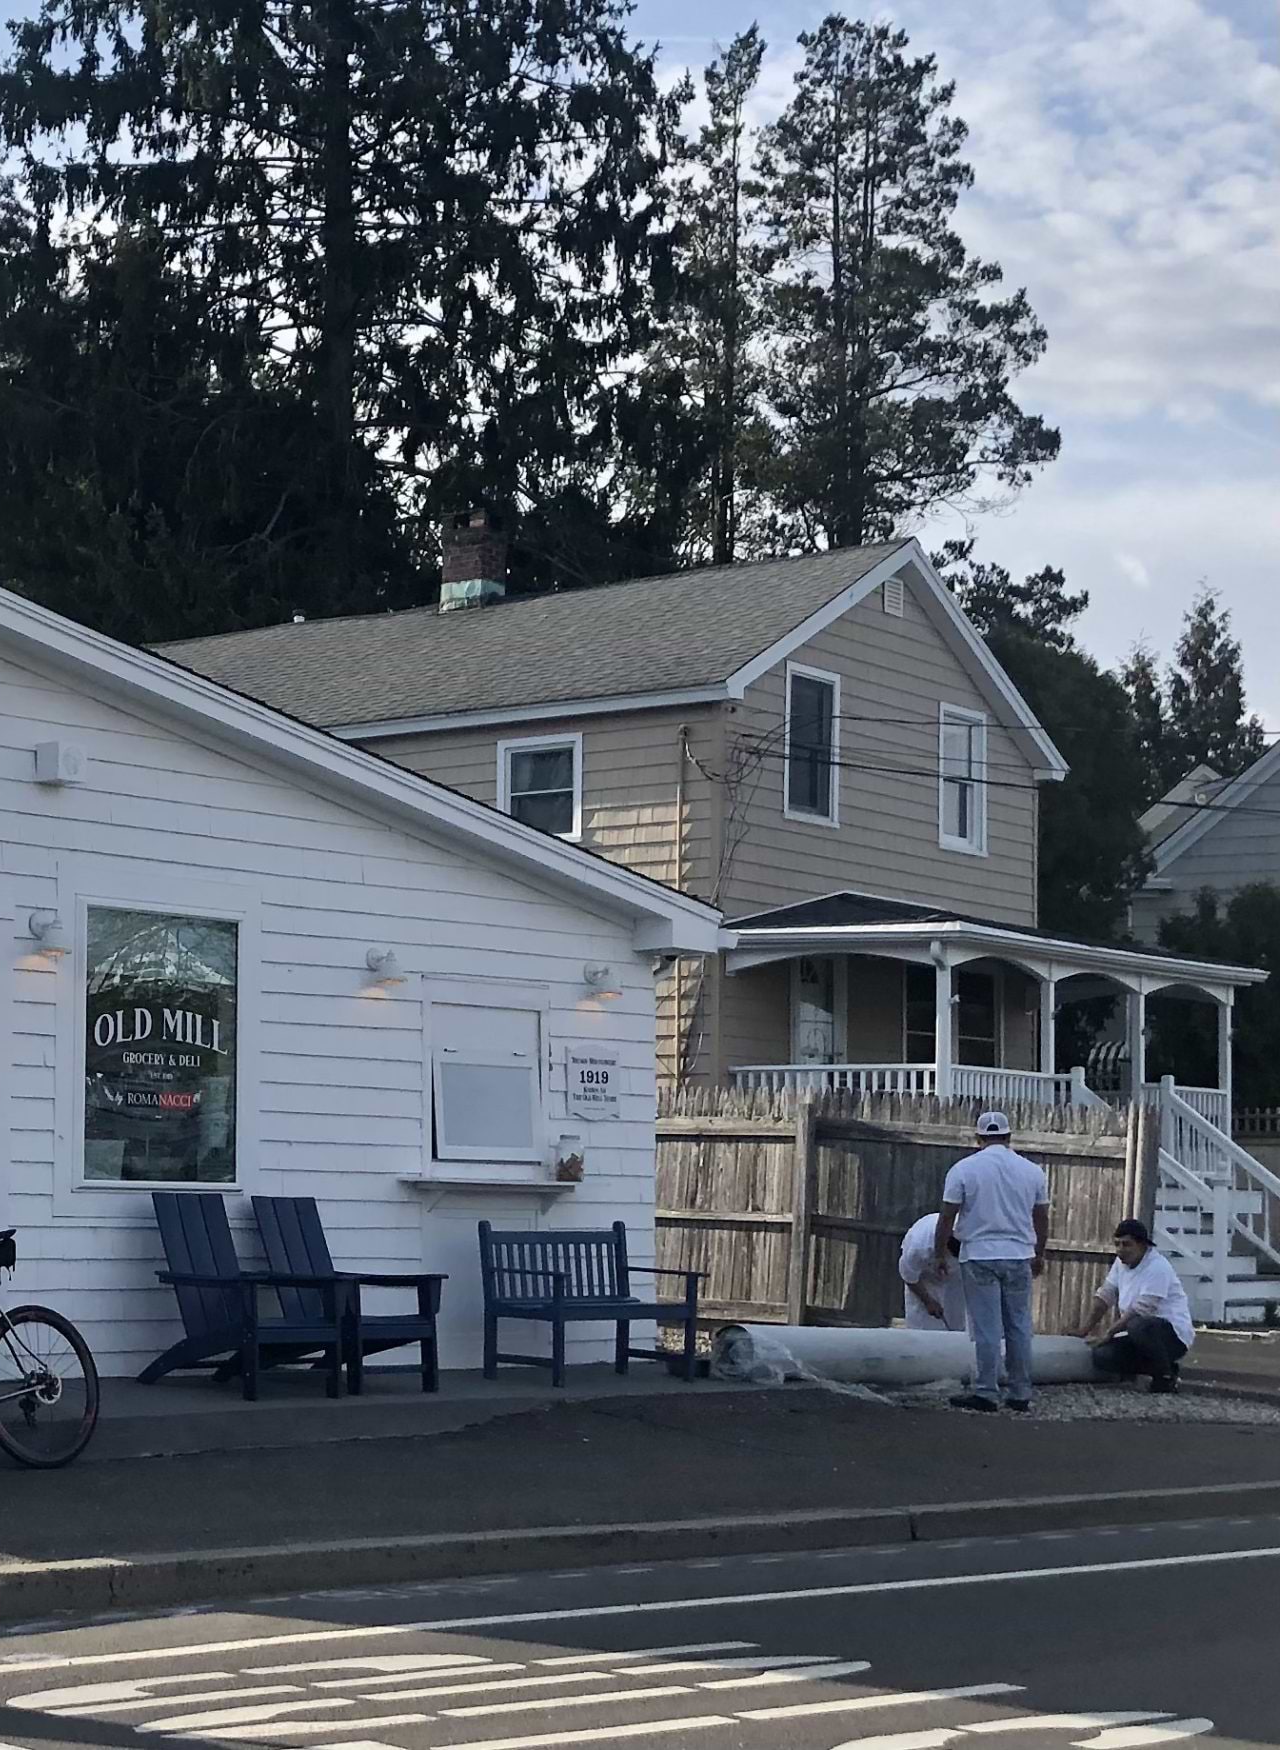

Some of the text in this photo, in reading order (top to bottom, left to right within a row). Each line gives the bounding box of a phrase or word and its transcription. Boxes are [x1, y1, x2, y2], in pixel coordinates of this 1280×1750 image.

[94, 1007, 228, 1056] OLD MILL
[122, 1051, 201, 1067] GROCERY & DELI
[579, 1070, 609, 1084] 1919
[127, 1092, 192, 1108] ROMANACCI
